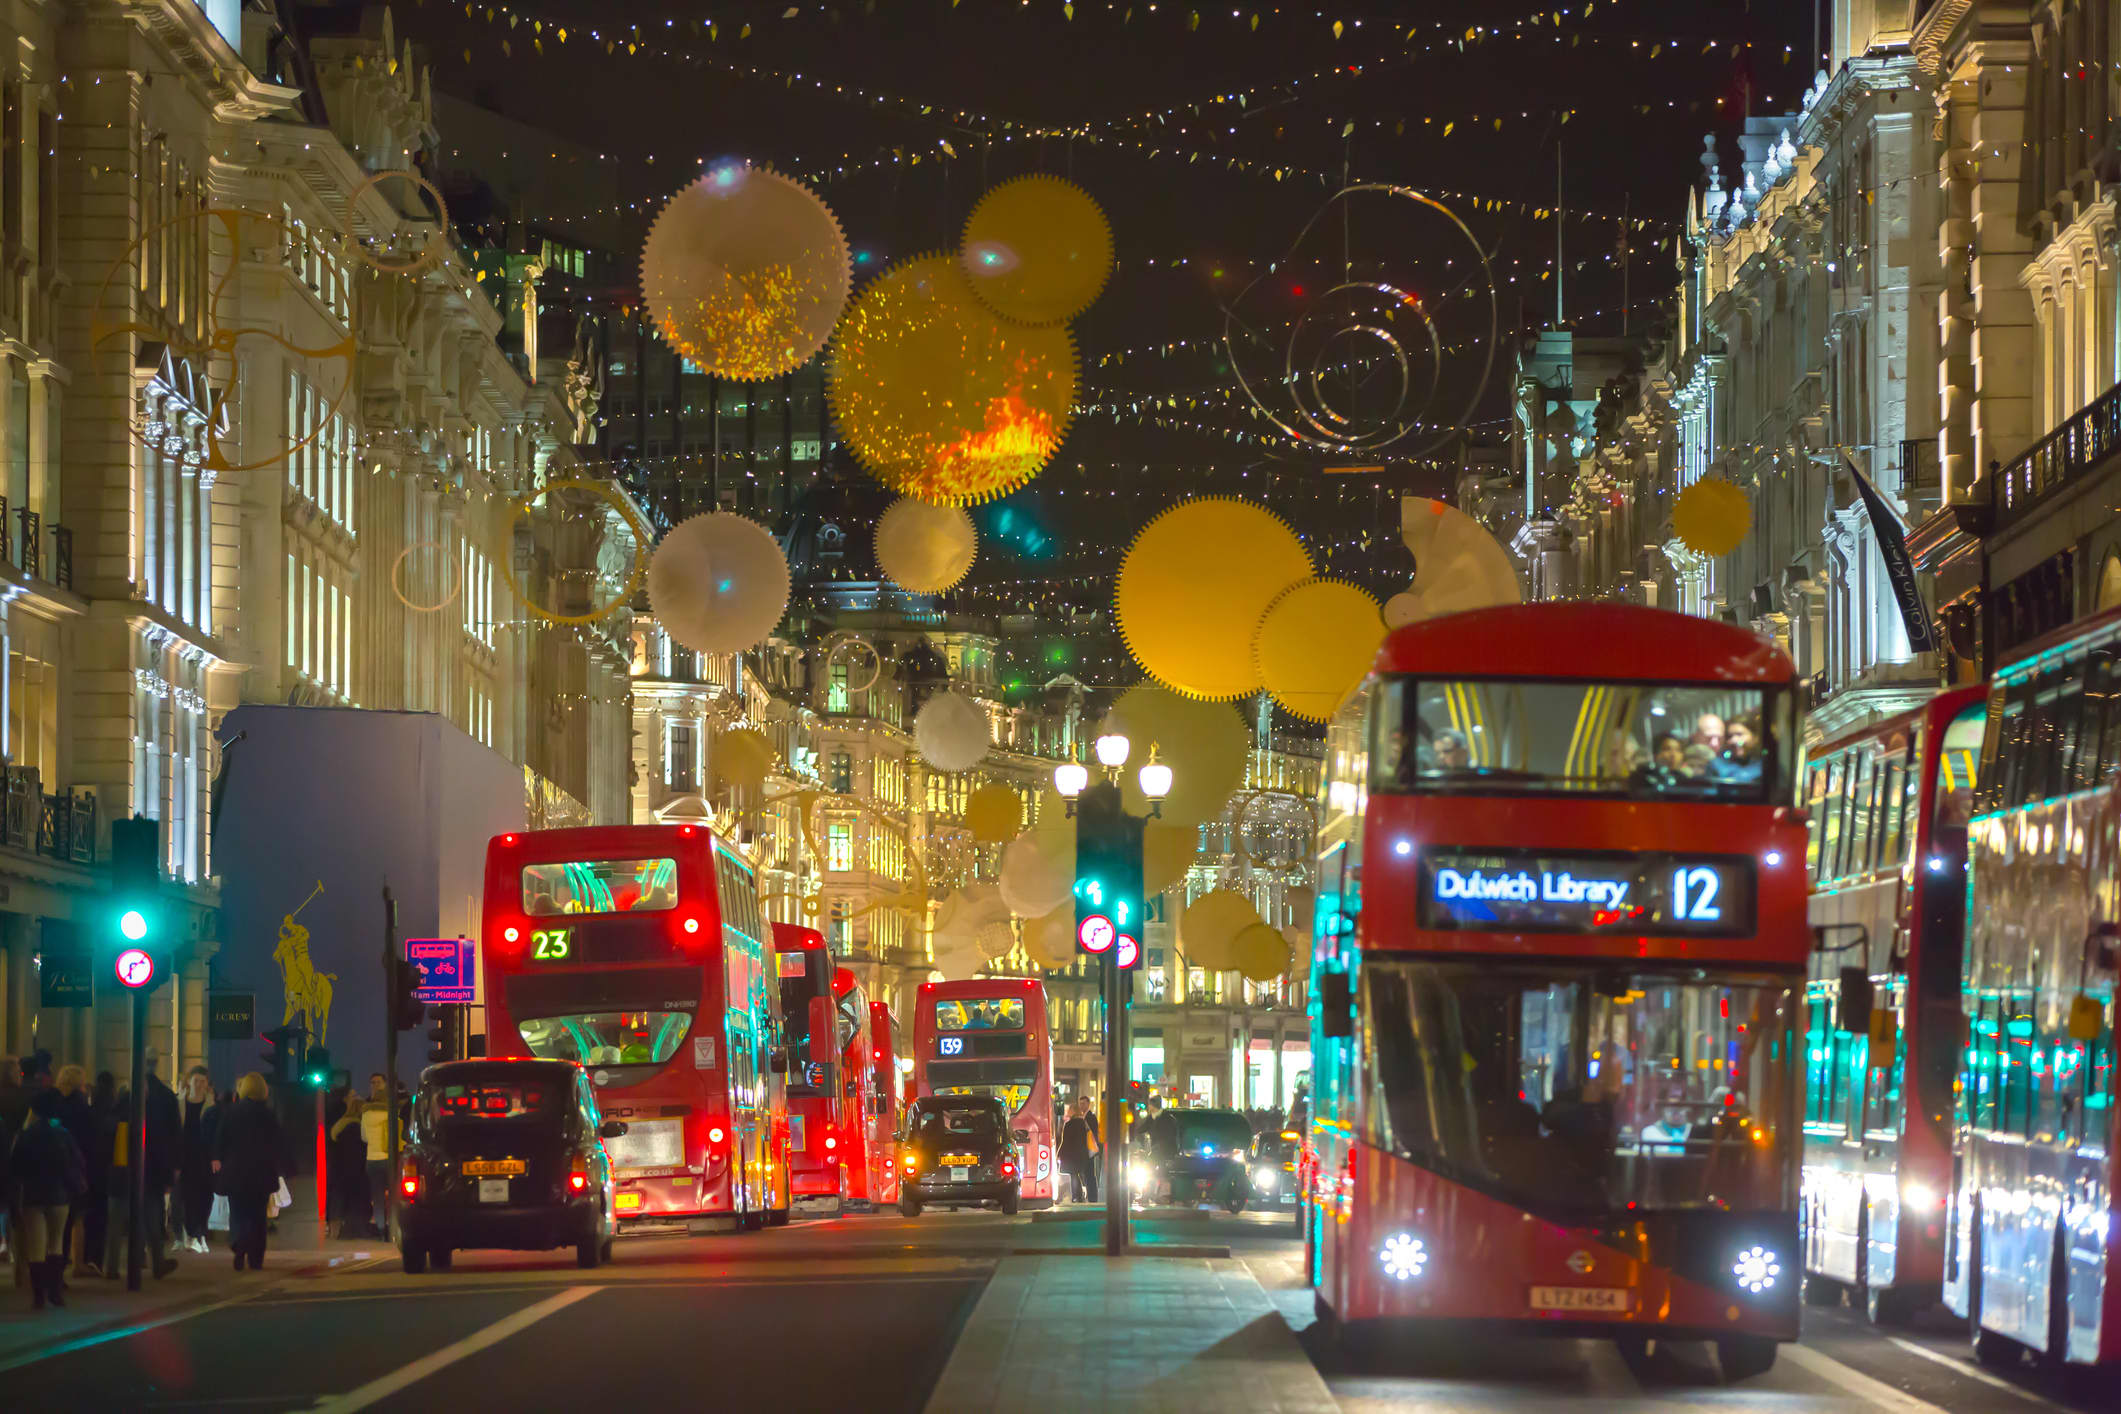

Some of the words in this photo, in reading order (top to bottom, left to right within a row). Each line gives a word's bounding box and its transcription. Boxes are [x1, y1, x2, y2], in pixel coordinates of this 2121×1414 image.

[1903, 581, 1927, 640] Calvin
[1437, 868, 1537, 901] Dulwich
[1542, 870, 1629, 911] Library
[1673, 866, 1721, 921] 12
[532, 930, 568, 959] 23
[435, 991, 471, 1000] Midnight
[940, 1037, 963, 1055] 139
